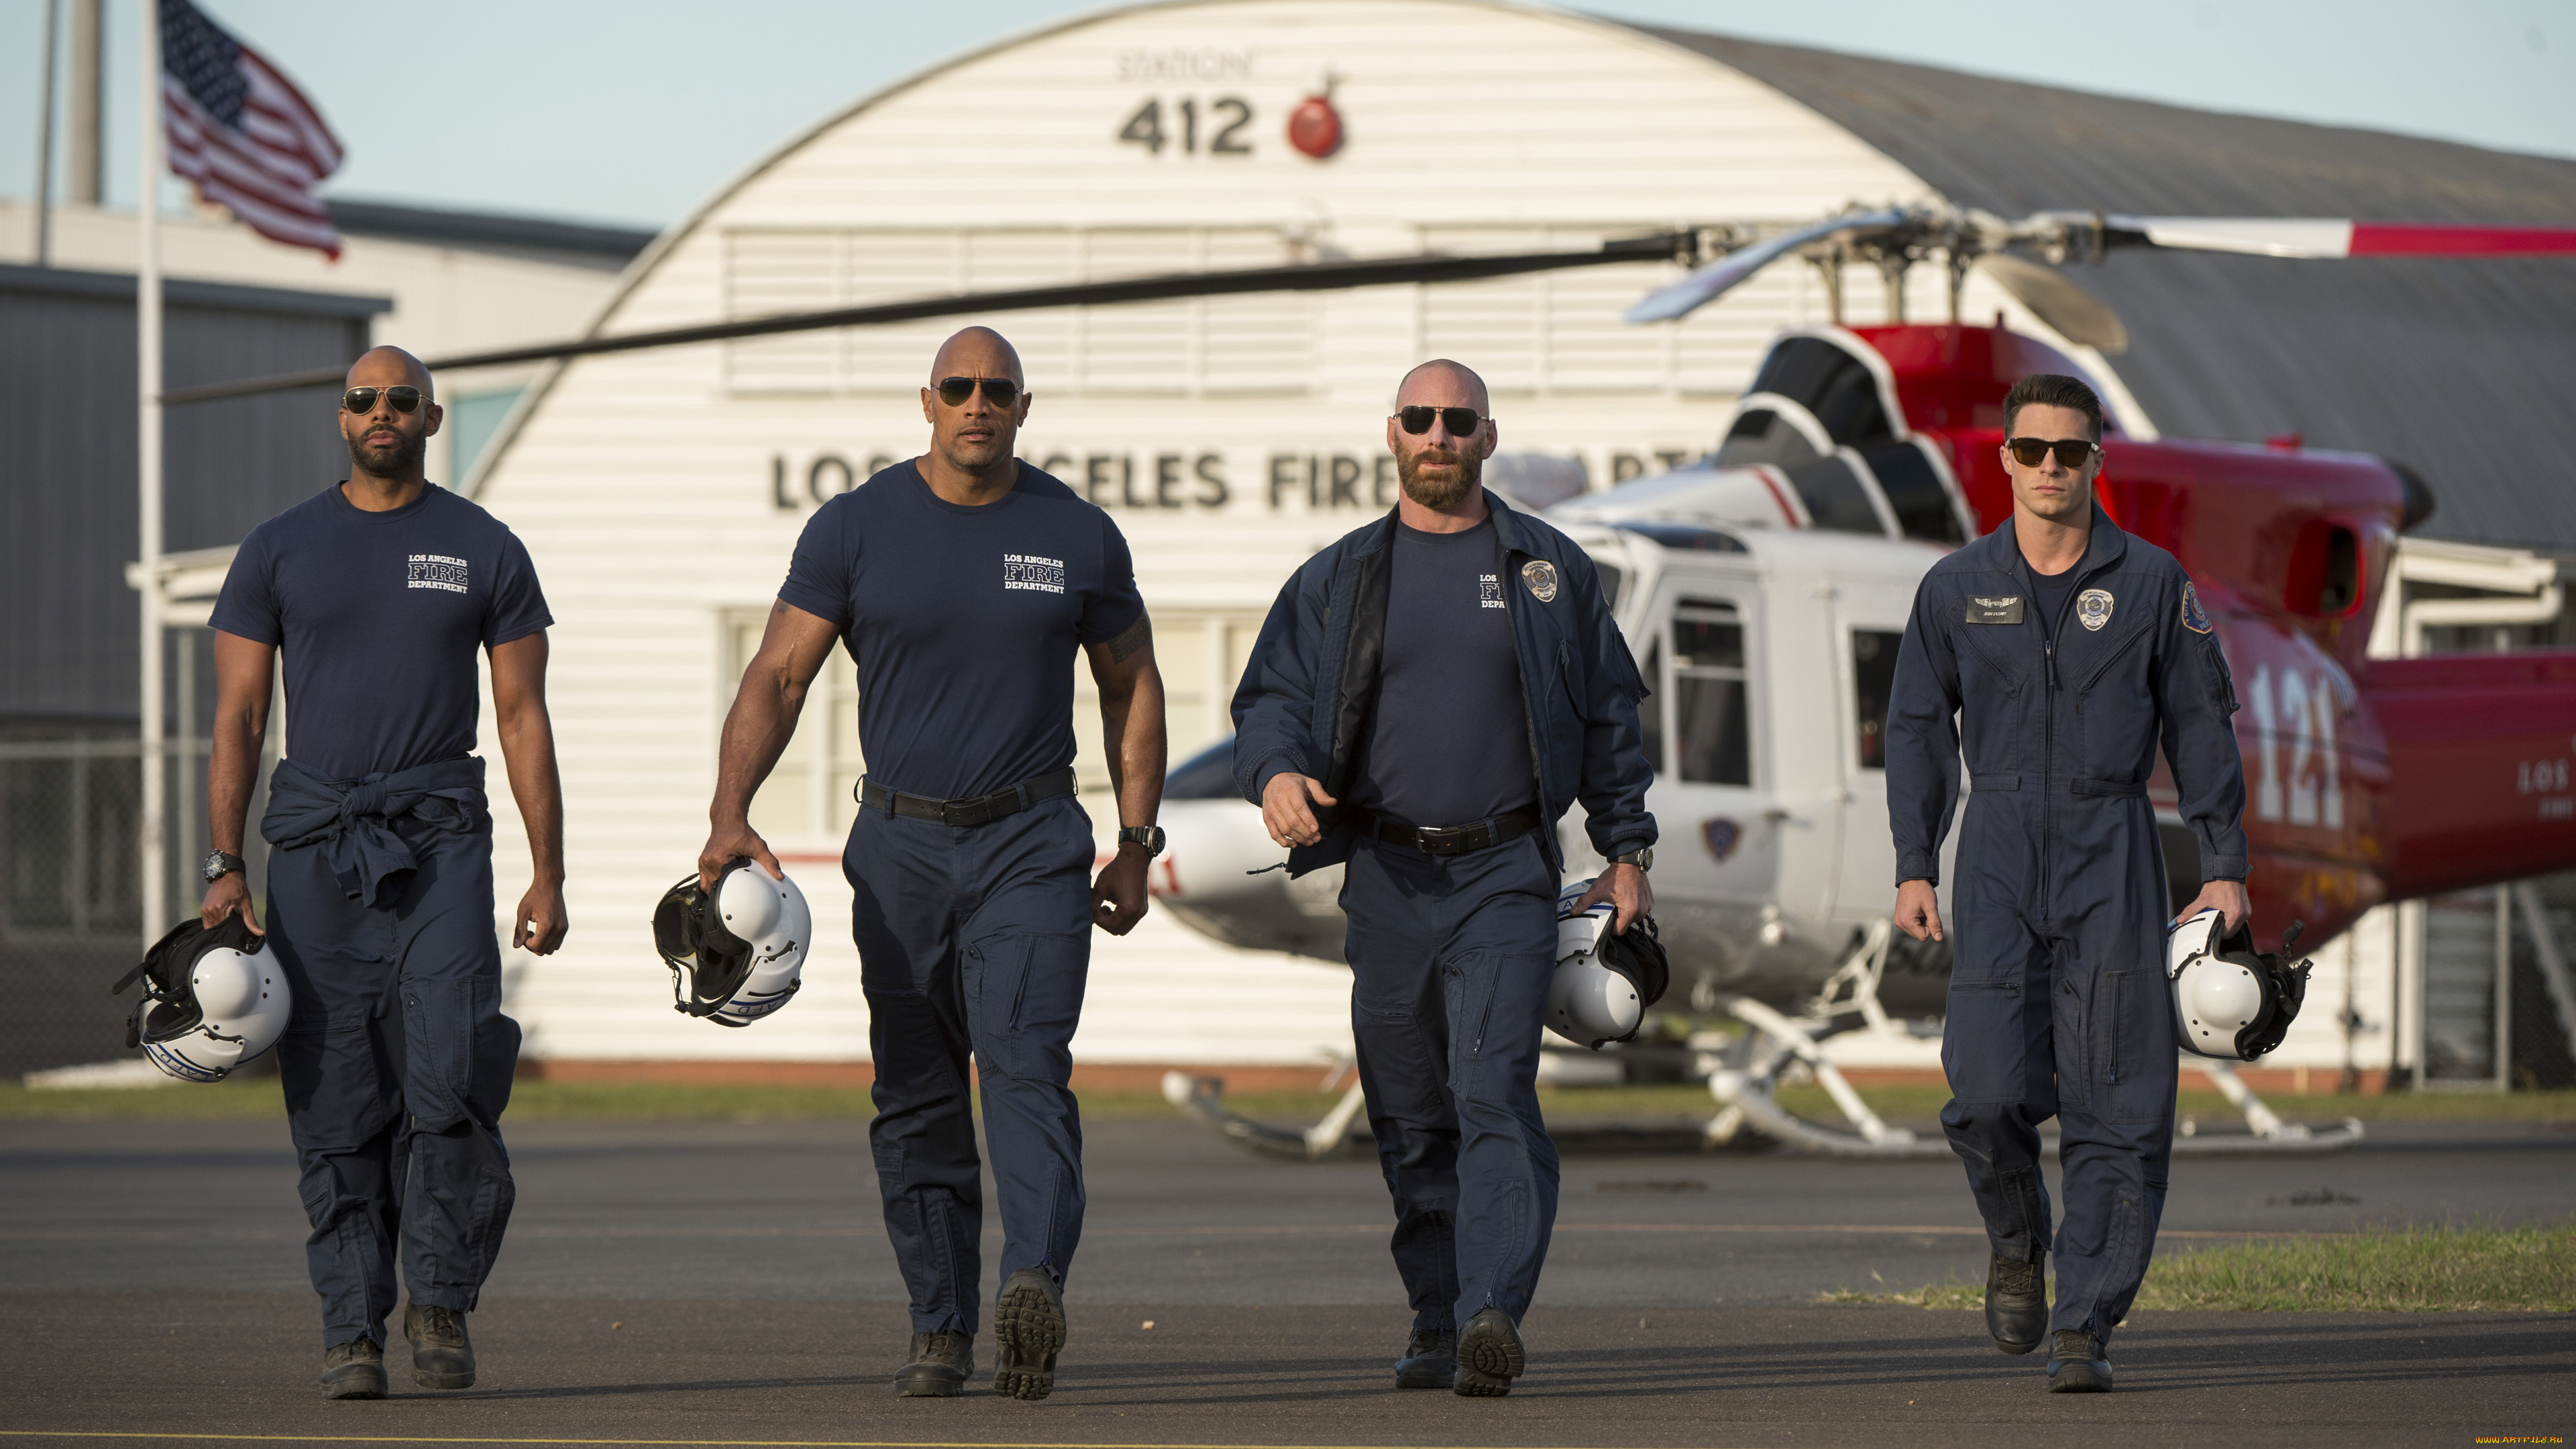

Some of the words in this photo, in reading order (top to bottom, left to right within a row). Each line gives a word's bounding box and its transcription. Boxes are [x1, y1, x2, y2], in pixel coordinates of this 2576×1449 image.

[1118, 94, 1255, 154] 412
[1269, 454, 1398, 508] FIRE
[427, 555, 468, 567] ANGELES
[1004, 554, 1022, 562] LOS
[1024, 555, 1063, 568] ANGELES
[408, 563, 468, 586] FIRE
[1004, 563, 1064, 586] FIRE
[408, 581, 468, 594] DEPARTMENT
[1005, 581, 1064, 594] DEPARTMENT
[2248, 663, 2345, 830] 121
